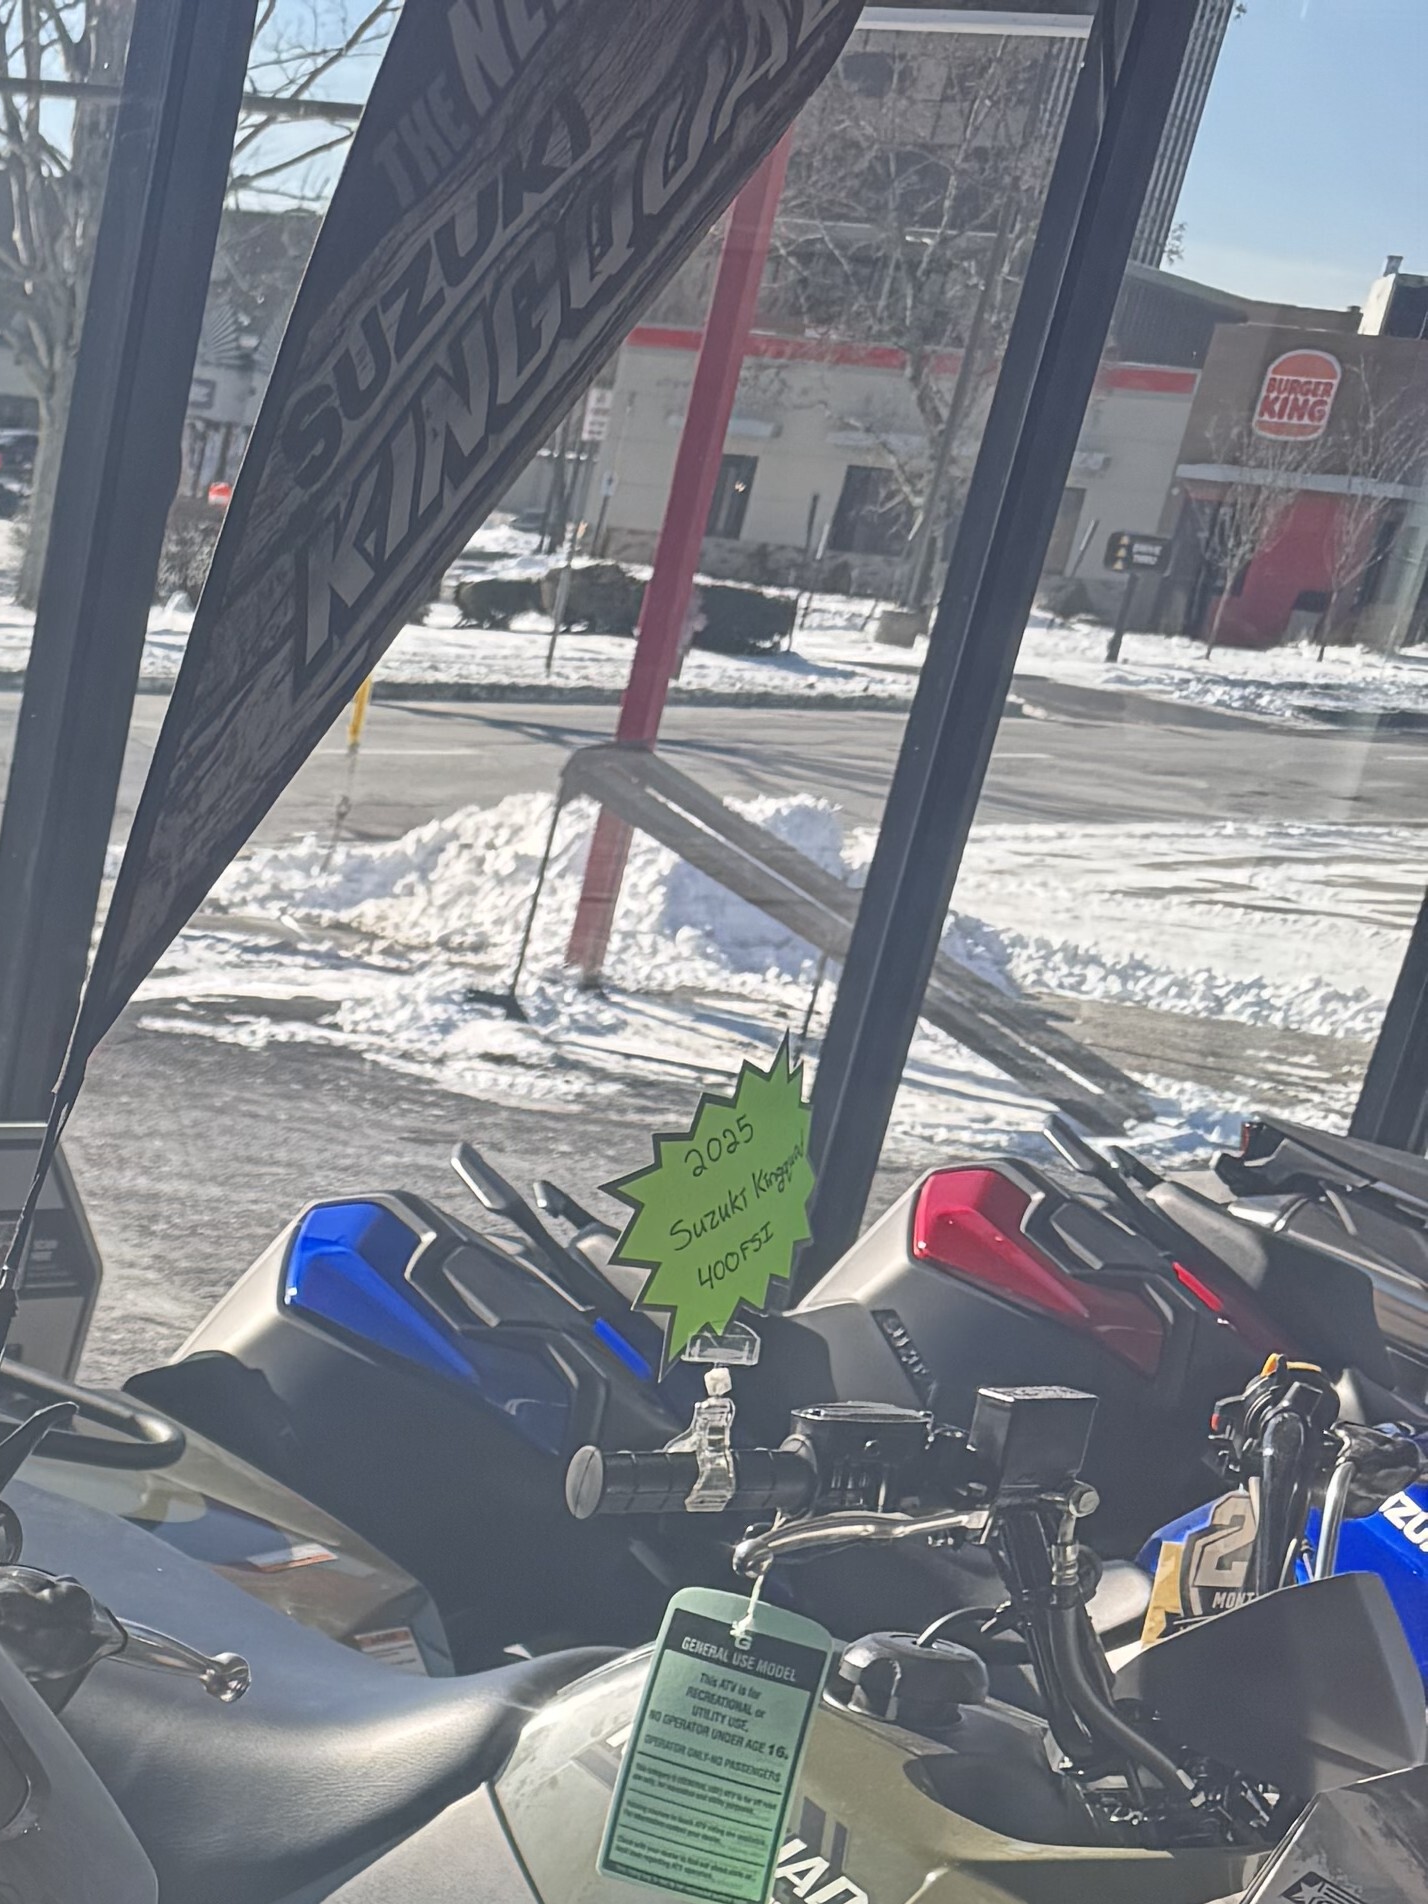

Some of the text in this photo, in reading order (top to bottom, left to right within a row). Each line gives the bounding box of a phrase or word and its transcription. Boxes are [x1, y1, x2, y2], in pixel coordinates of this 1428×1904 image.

[371, 75, 471, 208] THE
[279, 93, 591, 487] SUZUKI
[1266, 376, 1333, 398] BURGER
[1259, 394, 1327, 422] KING
[684, 1114, 754, 1178] 2025
[680, 1635, 797, 1683] GENERAL USE MODEL
[684, 1685, 766, 1719] RECREATIONAL or
[698, 1671, 762, 1700] This ATV is for
[647, 1709, 663, 1723] NO
[661, 1713, 711, 1737] OPERATOR
[710, 1727, 745, 1747] UNDER
[744, 1737, 766, 1753] AGE
[690, 1705, 727, 1725] UTILITY
